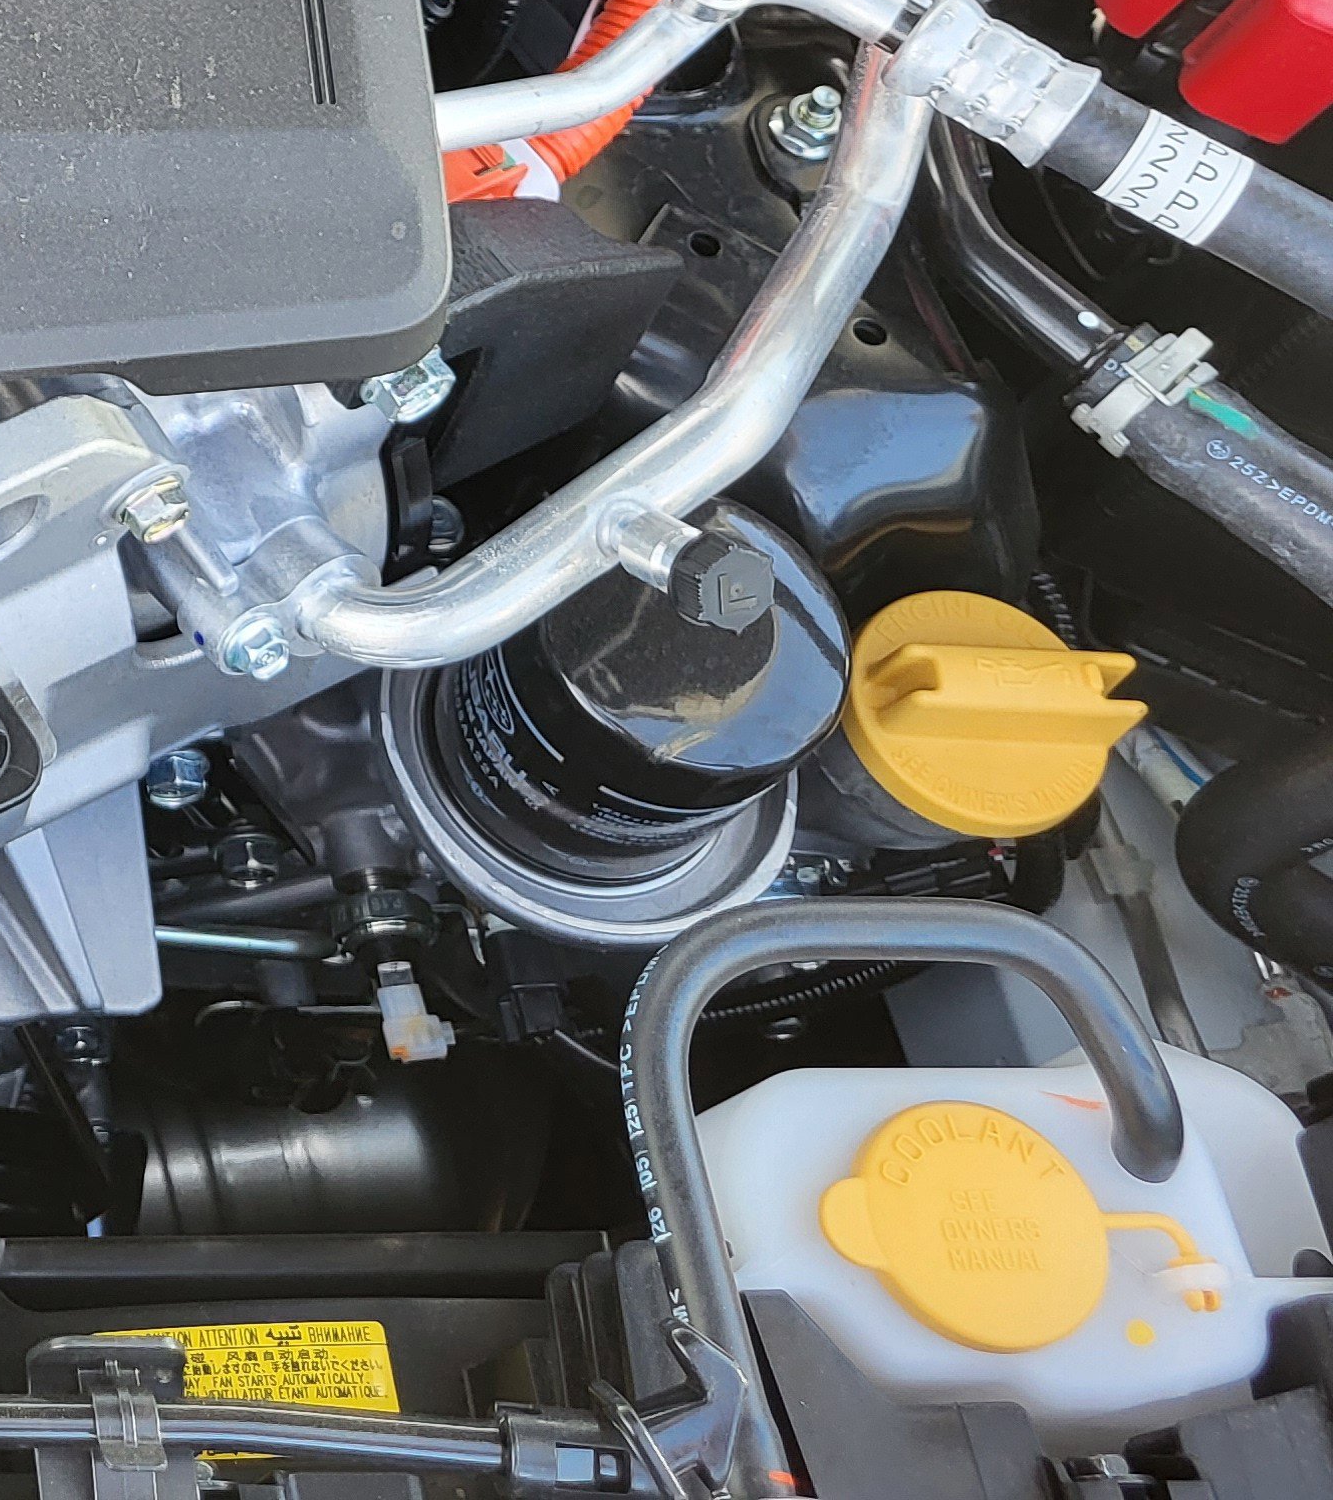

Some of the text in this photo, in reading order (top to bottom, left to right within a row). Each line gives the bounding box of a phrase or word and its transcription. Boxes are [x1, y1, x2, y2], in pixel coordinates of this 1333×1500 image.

[879, 1113, 1067, 1187] COOLANT
[949, 1189, 998, 1213] SEE
[947, 1248, 1042, 1272] MANUAL
[199, 1327, 260, 1348] ATTENTION
[307, 1326, 372, 1343] ВНИМАНИЕ
[213, 1375, 233, 1388] FAN
[238, 1374, 277, 1387] STARTS
[282, 1372, 371, 1385] AUTOMATICALLY.
